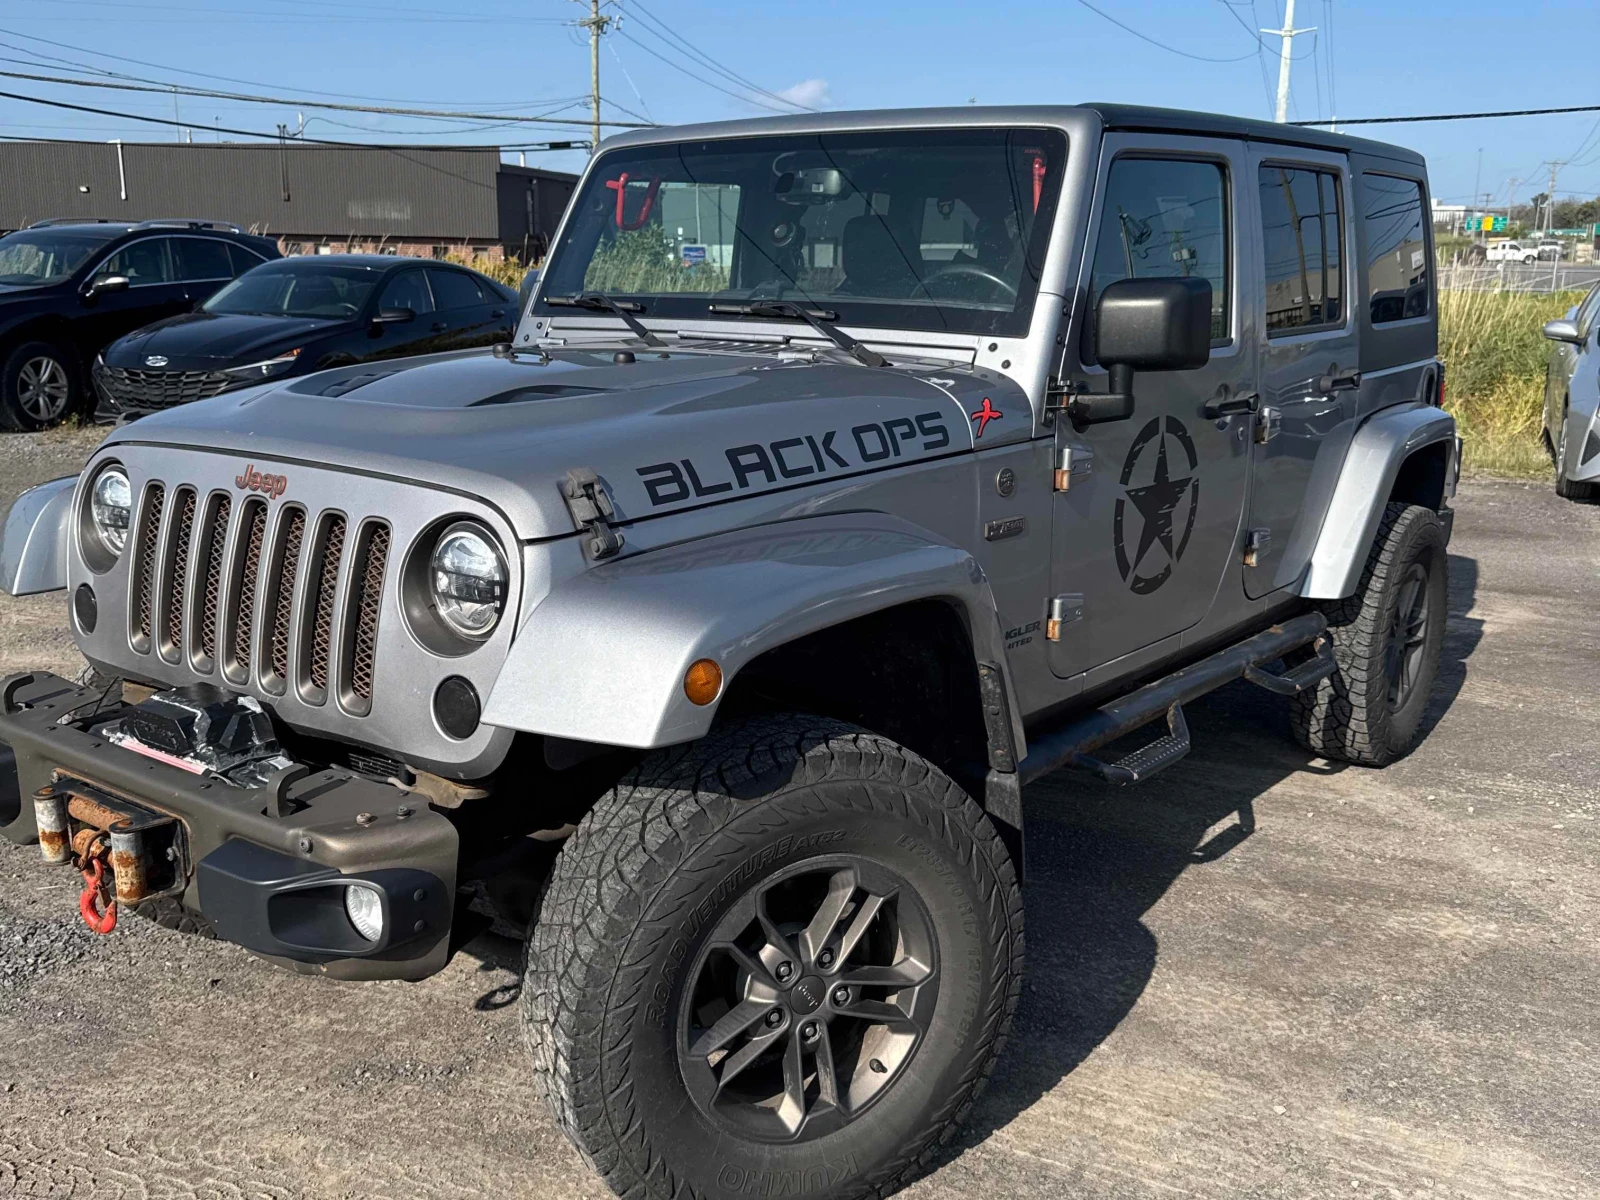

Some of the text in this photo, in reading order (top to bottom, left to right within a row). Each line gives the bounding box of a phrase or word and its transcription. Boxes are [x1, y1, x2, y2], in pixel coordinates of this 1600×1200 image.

[235, 464, 287, 500] Jeep
[636, 411, 949, 506] BLACK OPS
[643, 937, 688, 1028] ROAD
[679, 834, 794, 939] VENTURE
[717, 1153, 859, 1196] KUMHO
